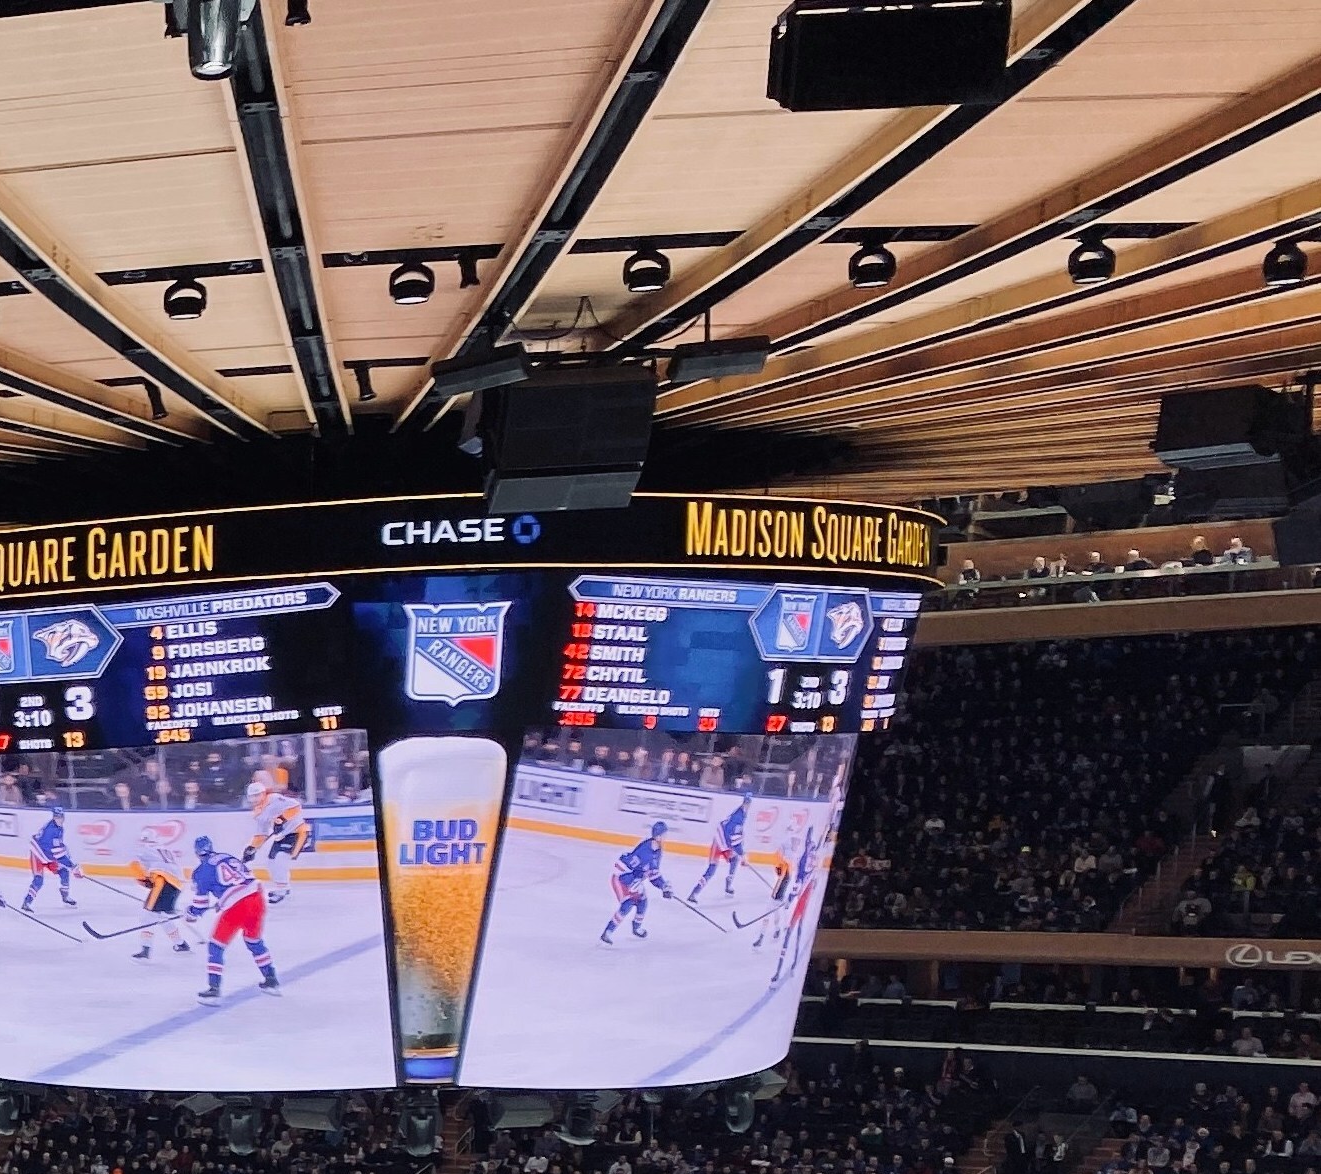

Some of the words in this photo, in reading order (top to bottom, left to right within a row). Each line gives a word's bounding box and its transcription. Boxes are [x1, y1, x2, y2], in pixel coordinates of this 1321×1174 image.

[380, 517, 506, 547] CHASE
[686, 500, 806, 558] MADISON
[811, 505, 884, 564] SQUARE
[886, 512, 931, 567] GARDEN
[86, 524, 215, 580] GARDEN
[611, 583, 644, 599] NEW
[644, 585, 677, 600] YORK
[676, 587, 738, 603] RANGERS
[135, 602, 210, 621] NASHVILLE
[210, 591, 308, 614] PREDATORS
[573, 602, 596, 617] 14
[596, 603, 669, 623] MCKEGG
[149, 625, 164, 641] 4
[165, 620, 219, 640] ELLIS
[415, 615, 454, 633] NEW
[458, 614, 498, 633] YORK
[592, 624, 649, 643] STAAL
[151, 644, 166, 661] 9
[167, 636, 266, 660] FORSBERG
[563, 642, 590, 661] 42
[589, 643, 647, 663] SMITH
[146, 665, 168, 681] 19
[168, 655, 274, 680] JARNKROK
[426, 638, 493, 691] RANGERS
[562, 663, 587, 680] 72
[586, 665, 650, 684] CHYTIL
[170, 681, 214, 699] JOSI
[559, 685, 583, 701] 77
[581, 685, 672, 706] DEANGELO
[767, 668, 787, 705] 1
[827, 669, 851, 706] 3
[18, 694, 45, 708] 2ND
[63, 685, 95, 721] 3
[145, 704, 172, 721] 92
[172, 696, 274, 719] JOHANSEN
[311, 704, 343, 718] HITS
[791, 690, 823, 710] 3:10
[12, 708, 54, 728] 3:10
[244, 722, 267, 738] 12
[318, 715, 339, 730] 11
[62, 731, 86, 748] 13
[412, 818, 478, 841] BUD
[399, 842, 487, 865] LIGHT
